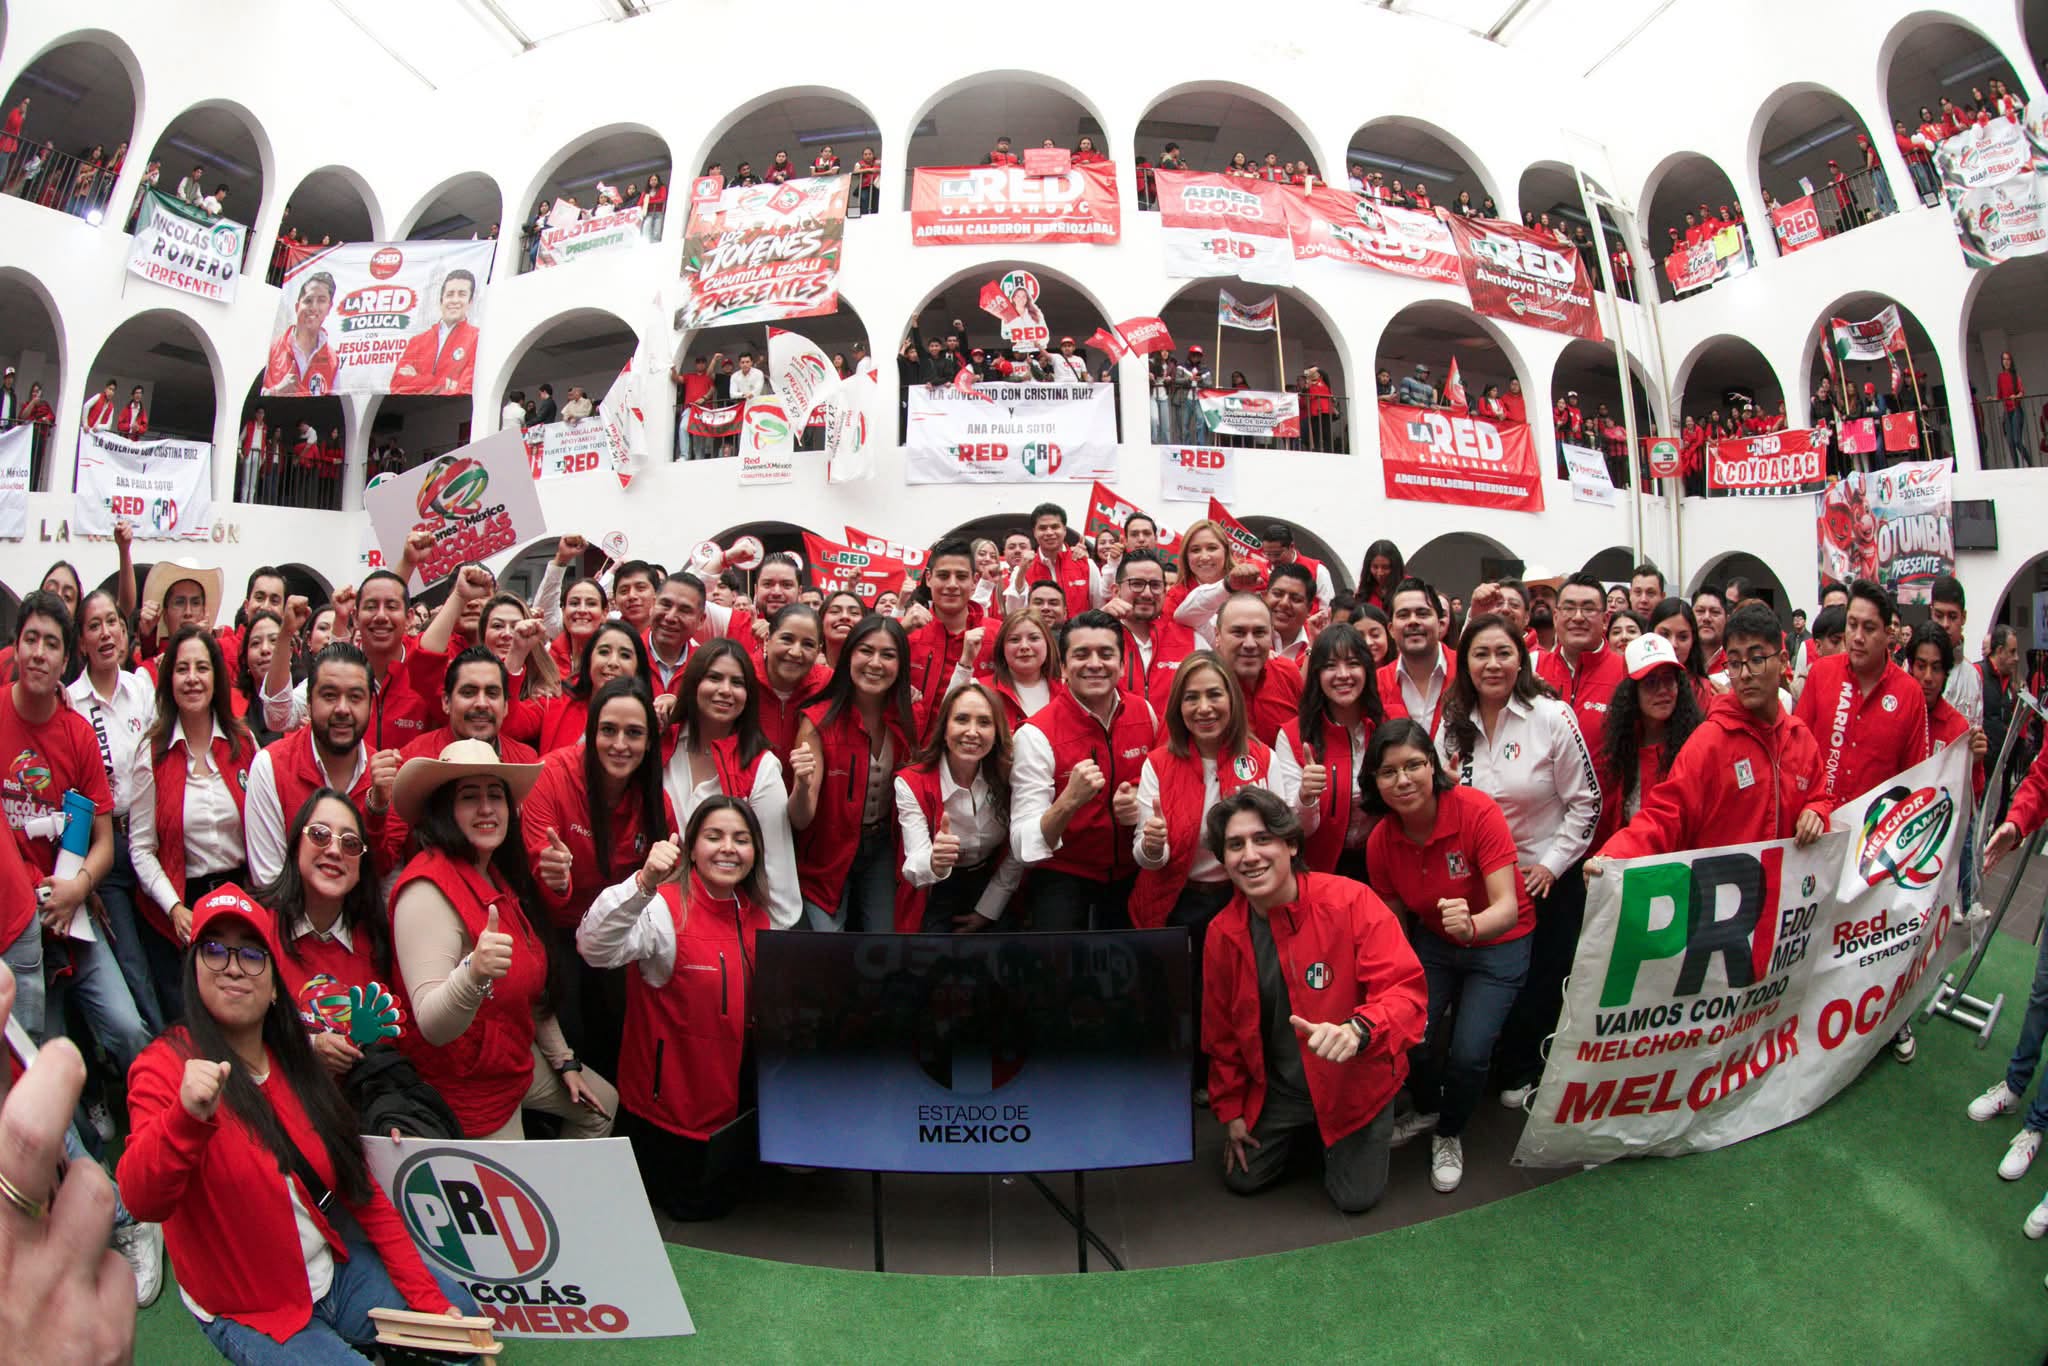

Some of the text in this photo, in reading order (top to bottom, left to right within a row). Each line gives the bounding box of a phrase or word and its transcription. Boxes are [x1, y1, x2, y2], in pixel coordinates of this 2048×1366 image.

[969, 167, 1085, 202] RED
[1184, 187, 1259, 205] ABNER
[1188, 199, 1260, 217] ROJO
[917, 225, 963, 237] ADRIAN
[966, 224, 1031, 235] CALDERON
[1783, 211, 1816, 238] RED
[152, 236, 233, 281] ROMERO
[1486, 232, 1576, 283] RED
[1477, 268, 1534, 293] Almoloya
[345, 289, 412, 313] LA RED
[350, 315, 400, 329] TOLUCA
[1011, 326, 1047, 342] RED
[336, 338, 407, 353] JESÚS DAVID
[1001, 389, 1022, 400] CON
[1024, 388, 1069, 400] CRISTINA
[1072, 388, 1094, 400] RUIZ
[967, 424, 987, 434] ANA
[991, 424, 1024, 434] PAULA
[1407, 413, 1503, 461] LA RED
[957, 444, 1009, 461] RED
[1753, 436, 1781, 456] RED
[563, 451, 599, 473] RED
[744, 457, 760, 465] Red
[1180, 449, 1225, 469] RED
[111, 496, 145, 515] RED
[40, 519, 70, 542] LA
[1096, 501, 1176, 545] LA RD
[1233, 529, 1263, 549] RED
[1879, 514, 1954, 562] OTUMBA
[822, 552, 868, 565] La RED
[1891, 556, 1940, 577] PRESENTE
[399, 719, 415, 728] RED
[1831, 682, 1853, 748] MARIO
[90, 706, 114, 776] LUPITA
[4, 779, 21, 791] Red
[1864, 795, 1925, 859] MELCHOR
[1897, 800, 1951, 846] OCAMPO
[1599, 847, 1784, 1007] PRI
[1780, 903, 1818, 936] EDO
[1833, 909, 1888, 946] Red
[1771, 933, 1811, 974] MEX
[1859, 941, 1910, 968] ESTADO
[1595, 975, 1789, 1036] VAMOS CON TODO
[1576, 1028, 1704, 1063] MELCHOR
[1554, 1014, 1799, 1124] MELCHOR
[918, 1105, 1029, 1121] ESTADO DE
[408, 1180, 534, 1251] PRI
[477, 1304, 629, 1333] MERO
